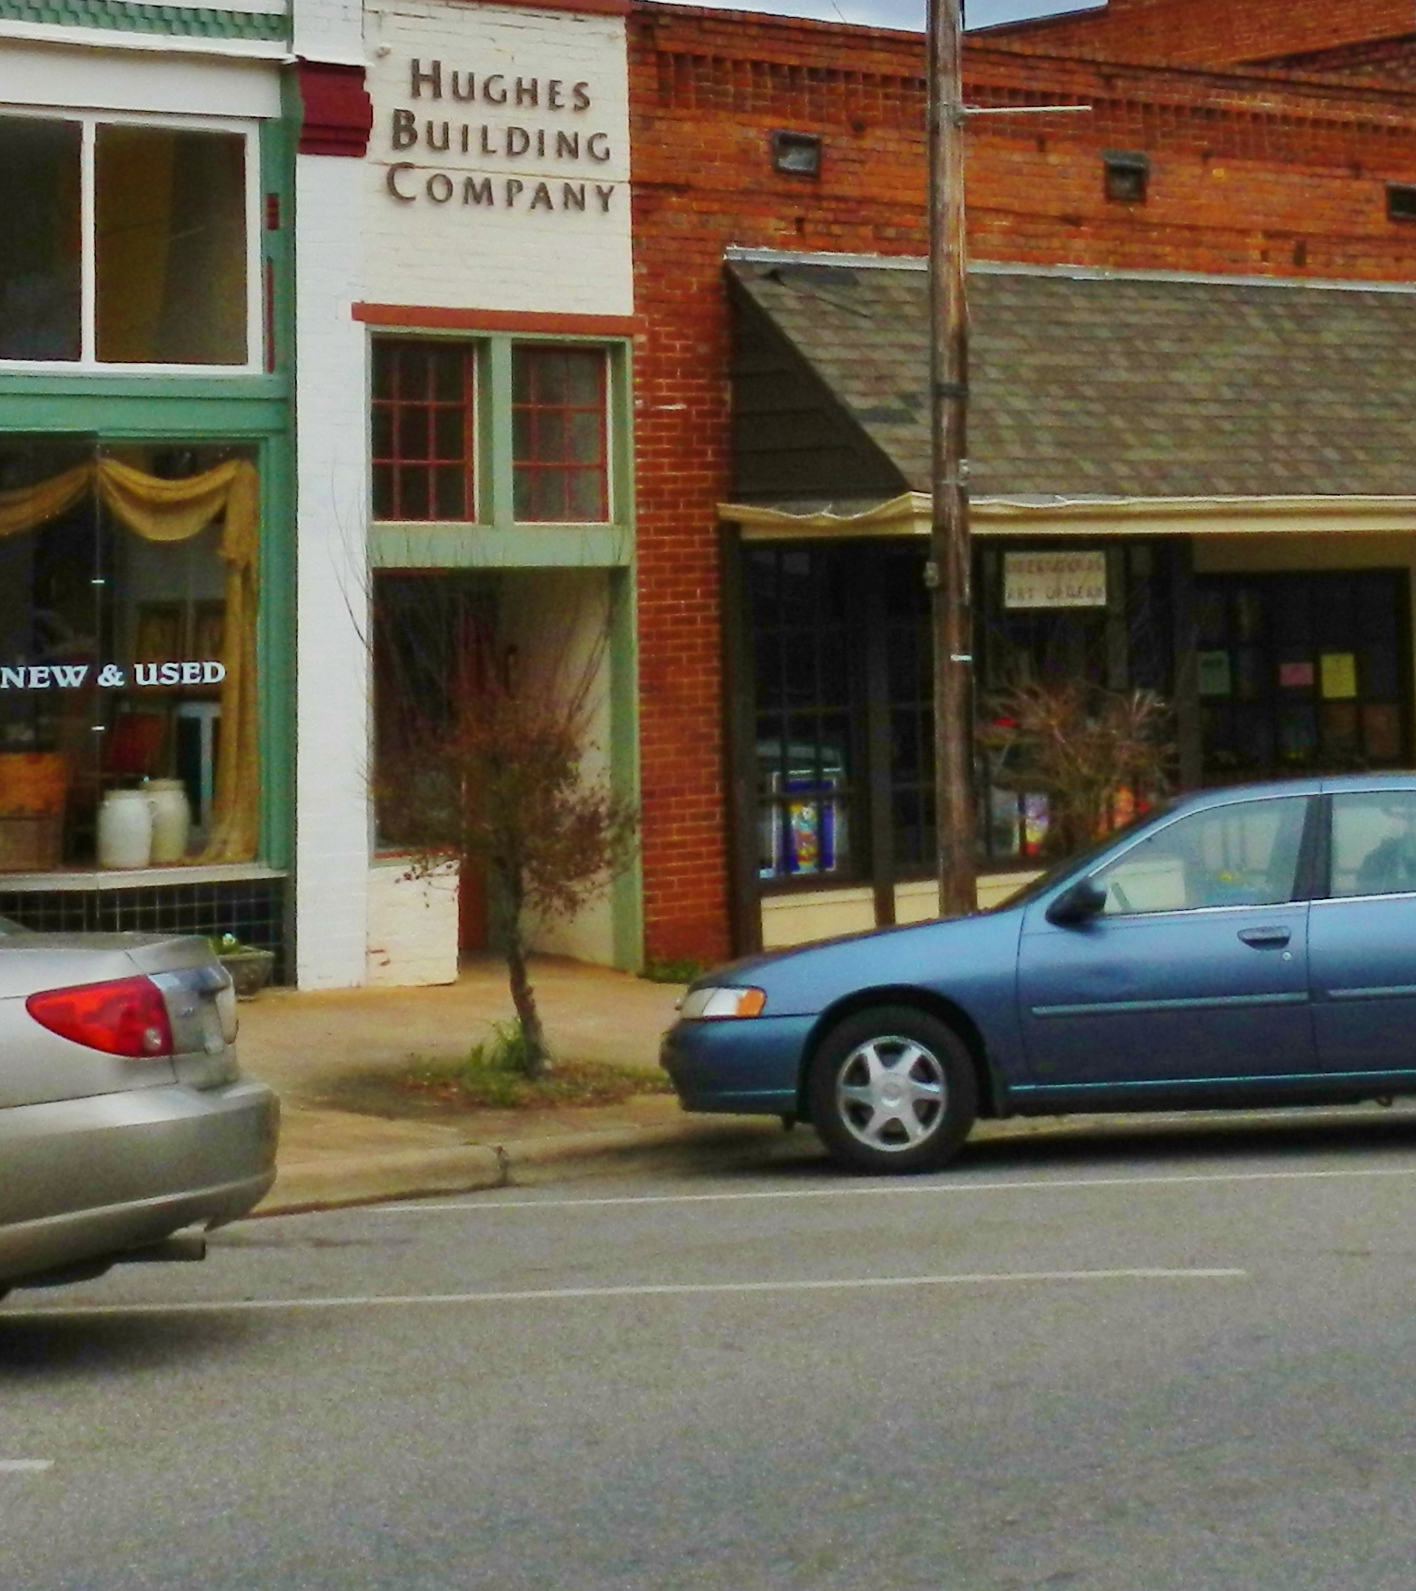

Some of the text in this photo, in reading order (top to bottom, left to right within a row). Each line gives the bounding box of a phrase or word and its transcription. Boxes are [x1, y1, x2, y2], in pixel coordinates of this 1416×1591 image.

[411, 58, 591, 112] HUGHES
[392, 108, 611, 162] BUILDING
[386, 161, 615, 213] COMPANY
[0, 661, 226, 690] NEW & USED
